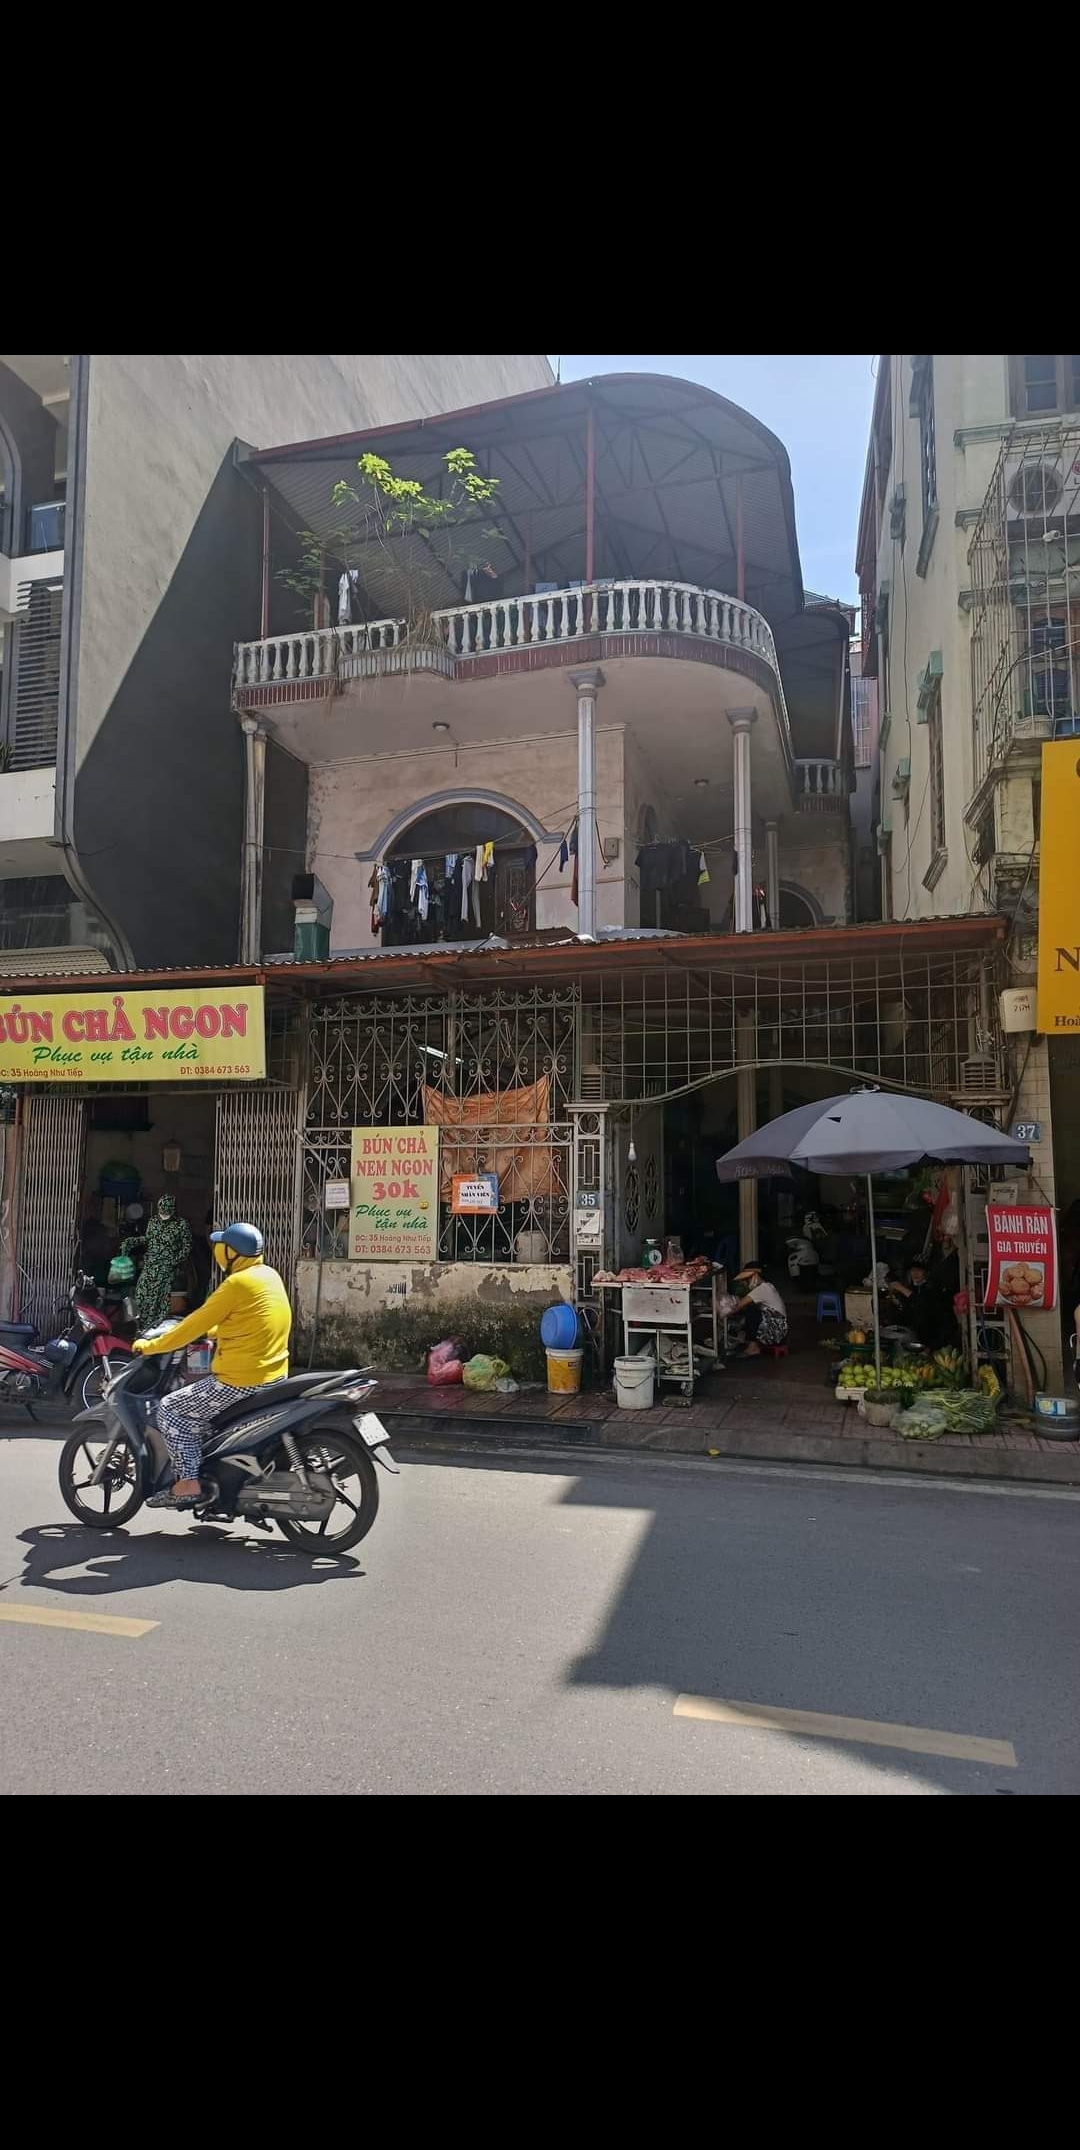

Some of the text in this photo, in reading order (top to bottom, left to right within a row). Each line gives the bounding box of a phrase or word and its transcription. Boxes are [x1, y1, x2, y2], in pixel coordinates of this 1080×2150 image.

[62, 996, 136, 1042] CHẢ
[142, 1003, 248, 1040] NGON
[32, 1043, 200, 1065] Phục vụ tận nhà
[0, 1068, 9, 1077] C:
[11, 1068, 21, 1077] 35
[50, 1068, 65, 1077] Như
[67, 1066, 83, 1079] Tiếp
[180, 1065, 250, 1075] ĐT: 0384 673 563
[1017, 1124, 1036, 1139] 37
[362, 1130, 428, 1155] BÚN CHẢ
[356, 1159, 434, 1177] NEM NGON
[373, 1179, 420, 1200] 30k
[581, 1193, 596, 1207] 35
[375, 1216, 429, 1231] tận nhà
[993, 1211, 1049, 1235] BÁNH RÁN
[369, 1233, 378, 1242] 35
[370, 1245, 392, 1253] 0384
[395, 1245, 411, 1254] 673
[414, 1245, 431, 1254] 563
[997, 1241, 1012, 1253] GIA
